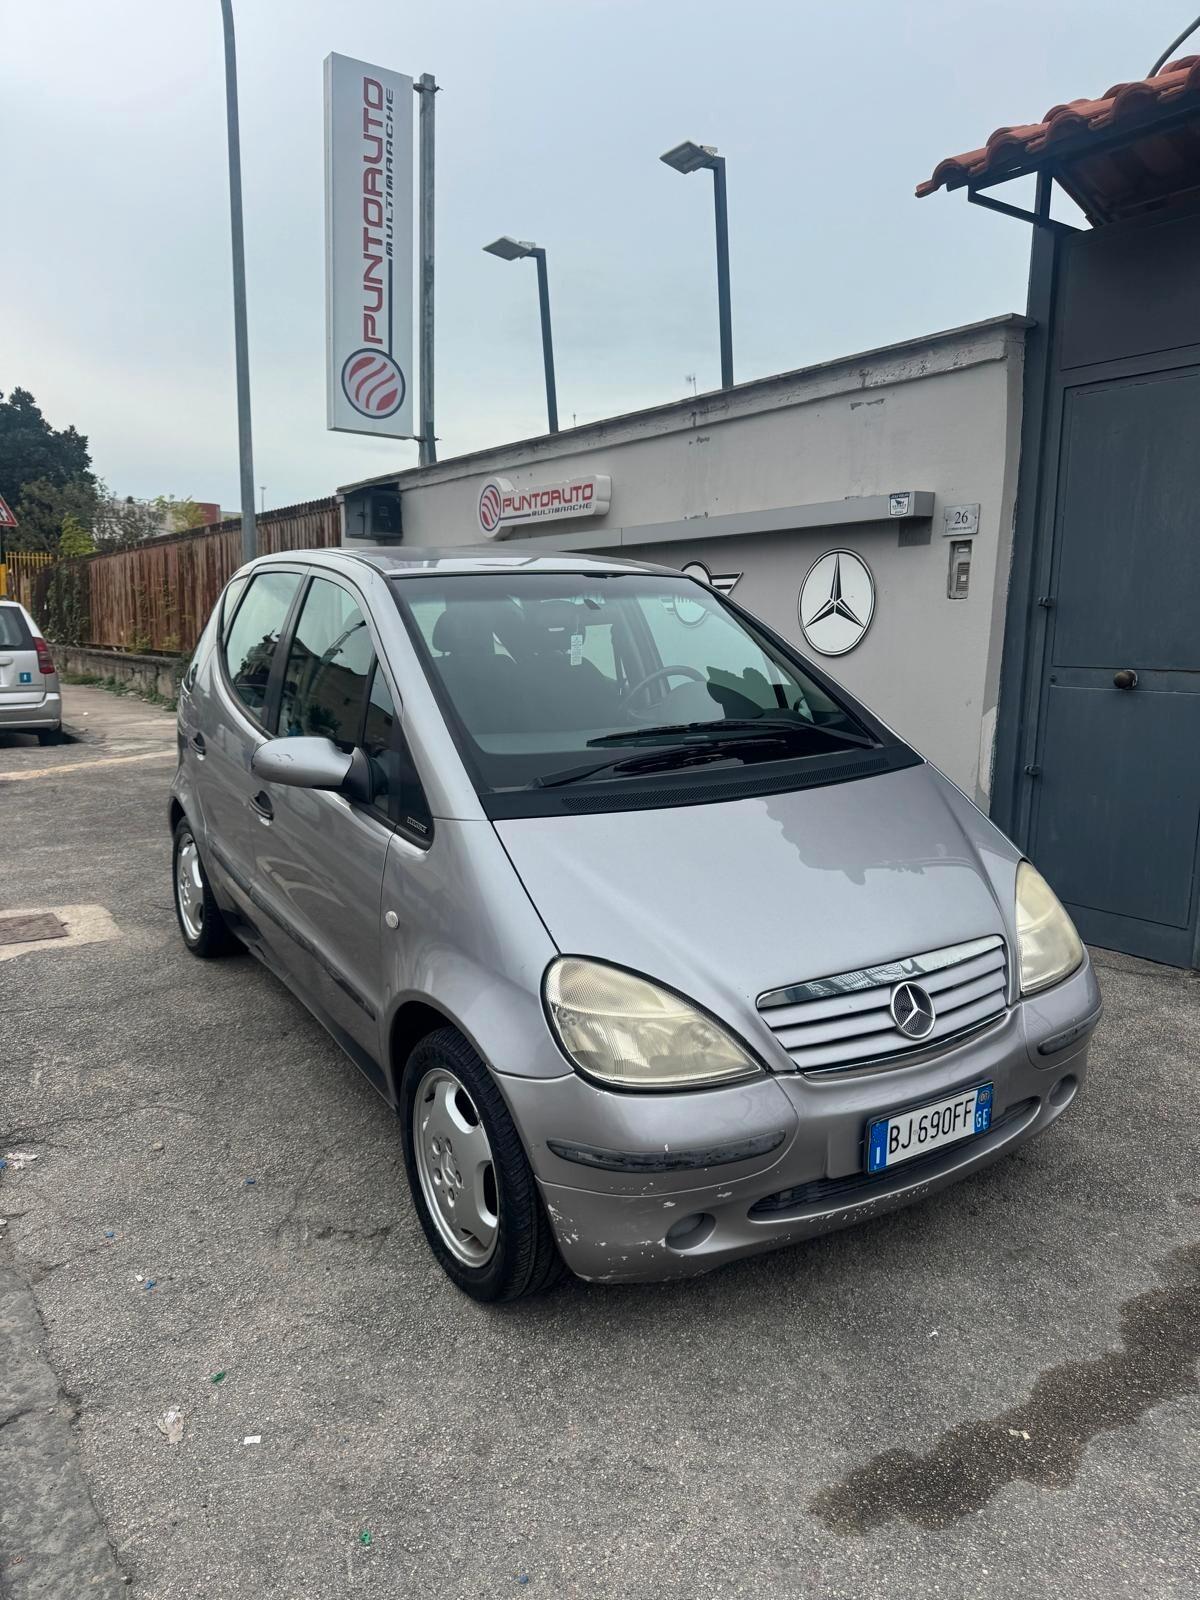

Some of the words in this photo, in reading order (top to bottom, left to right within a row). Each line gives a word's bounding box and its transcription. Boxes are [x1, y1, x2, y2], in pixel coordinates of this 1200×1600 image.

[363, 76, 384, 345] PUNTOAUTO
[502, 483, 594, 514] PUNTOAUTO
[954, 510, 969, 525] 26
[975, 1108, 989, 1131] GE
